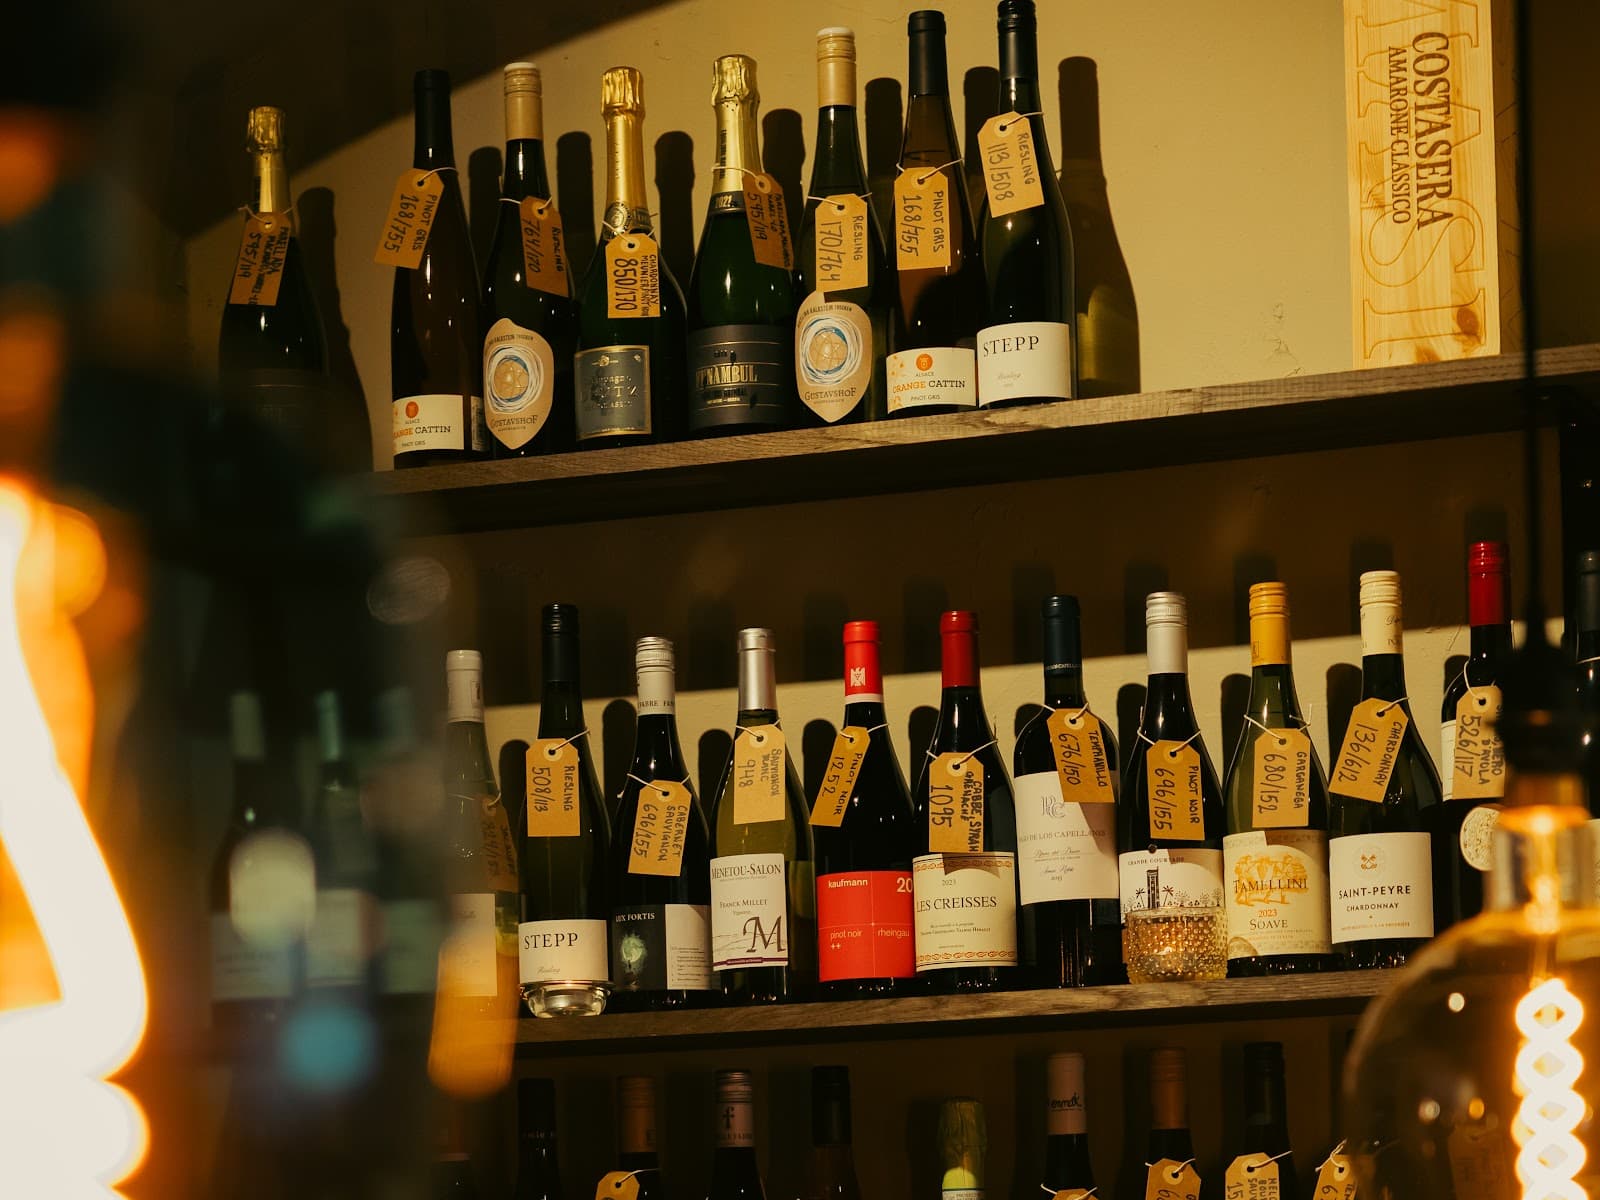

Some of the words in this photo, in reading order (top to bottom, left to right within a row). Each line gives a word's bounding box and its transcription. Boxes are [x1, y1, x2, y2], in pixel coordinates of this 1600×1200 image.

[1388, 46, 1409, 136] AMARONE
[1412, 31, 1453, 231] COSTASERA
[987, 142, 1015, 201] 113/508
[1017, 132, 1036, 185] RIESLING
[1391, 139, 1411, 225] CLASSICO
[384, 193, 420, 253] 168/755
[421, 193, 437, 225] PINOT
[748, 193, 768, 240] 595/119
[899, 195, 926, 256] 168/755
[933, 191, 944, 223] PINOT
[412, 228, 427, 251] GRIS
[523, 219, 544, 273] 764/170
[818, 221, 847, 281] 170/764
[852, 215, 864, 261] RIESLING
[932, 227, 945, 253] GRIS
[614, 258, 639, 311] 850/170
[983, 335, 1040, 357] STEPP
[804, 387, 857, 402] GUSTAVSHOF
[892, 381, 926, 394] ORANGE
[928, 380, 966, 389] CATTIN
[415, 425, 451, 436] CATTIN
[1058, 733, 1086, 785] 676/150
[1088, 730, 1106, 788] TEMPRANILLO
[1338, 723, 1379, 783] 136/612
[1373, 721, 1403, 787] CHARDONNAY
[1455, 715, 1481, 777] 526/117
[1478, 738, 1492, 785] D'AVOLA
[531, 766, 556, 813] 508/113
[563, 765, 576, 812] RIESLING
[739, 759, 756, 788] 948
[769, 748, 782, 797] SAUVIGNON
[822, 755, 845, 798] 1252
[846, 752, 864, 785] PINOT
[1188, 765, 1199, 795] PINOT
[1257, 753, 1287, 814] 680/152
[1293, 751, 1307, 809] GARGANEGA
[832, 790, 850, 816] NOIR
[930, 784, 954, 827] 1095
[960, 770, 974, 822] GRENACHE
[1153, 768, 1177, 830] 696/155
[1189, 799, 1200, 824] NOIR
[633, 803, 659, 858] 696/155
[658, 805, 676, 862] SAUVIGNON
[672, 805, 688, 858] CABERNET
[968, 821, 983, 853] SYRAH
[711, 863, 781, 881] MENETOU-SALON
[828, 878, 868, 889] kaufmann
[896, 877, 913, 893] 20
[1233, 877, 1308, 894] TAMELLINI
[1338, 884, 1411, 899] SAINT-PEYRE
[627, 912, 656, 921] FORTIS
[719, 901, 740, 909] FRANCK
[917, 898, 931, 913] LES
[933, 896, 997, 910] CREISSES
[1249, 918, 1289, 931] SOAVE
[1258, 909, 1278, 918] 2023
[1346, 902, 1400, 912] CHARDONNAY
[524, 932, 579, 950] STEPP
[743, 915, 787, 953] M
[830, 930, 846, 940] pinot
[847, 929, 862, 938] noir
[878, 928, 910, 938] rheingau
